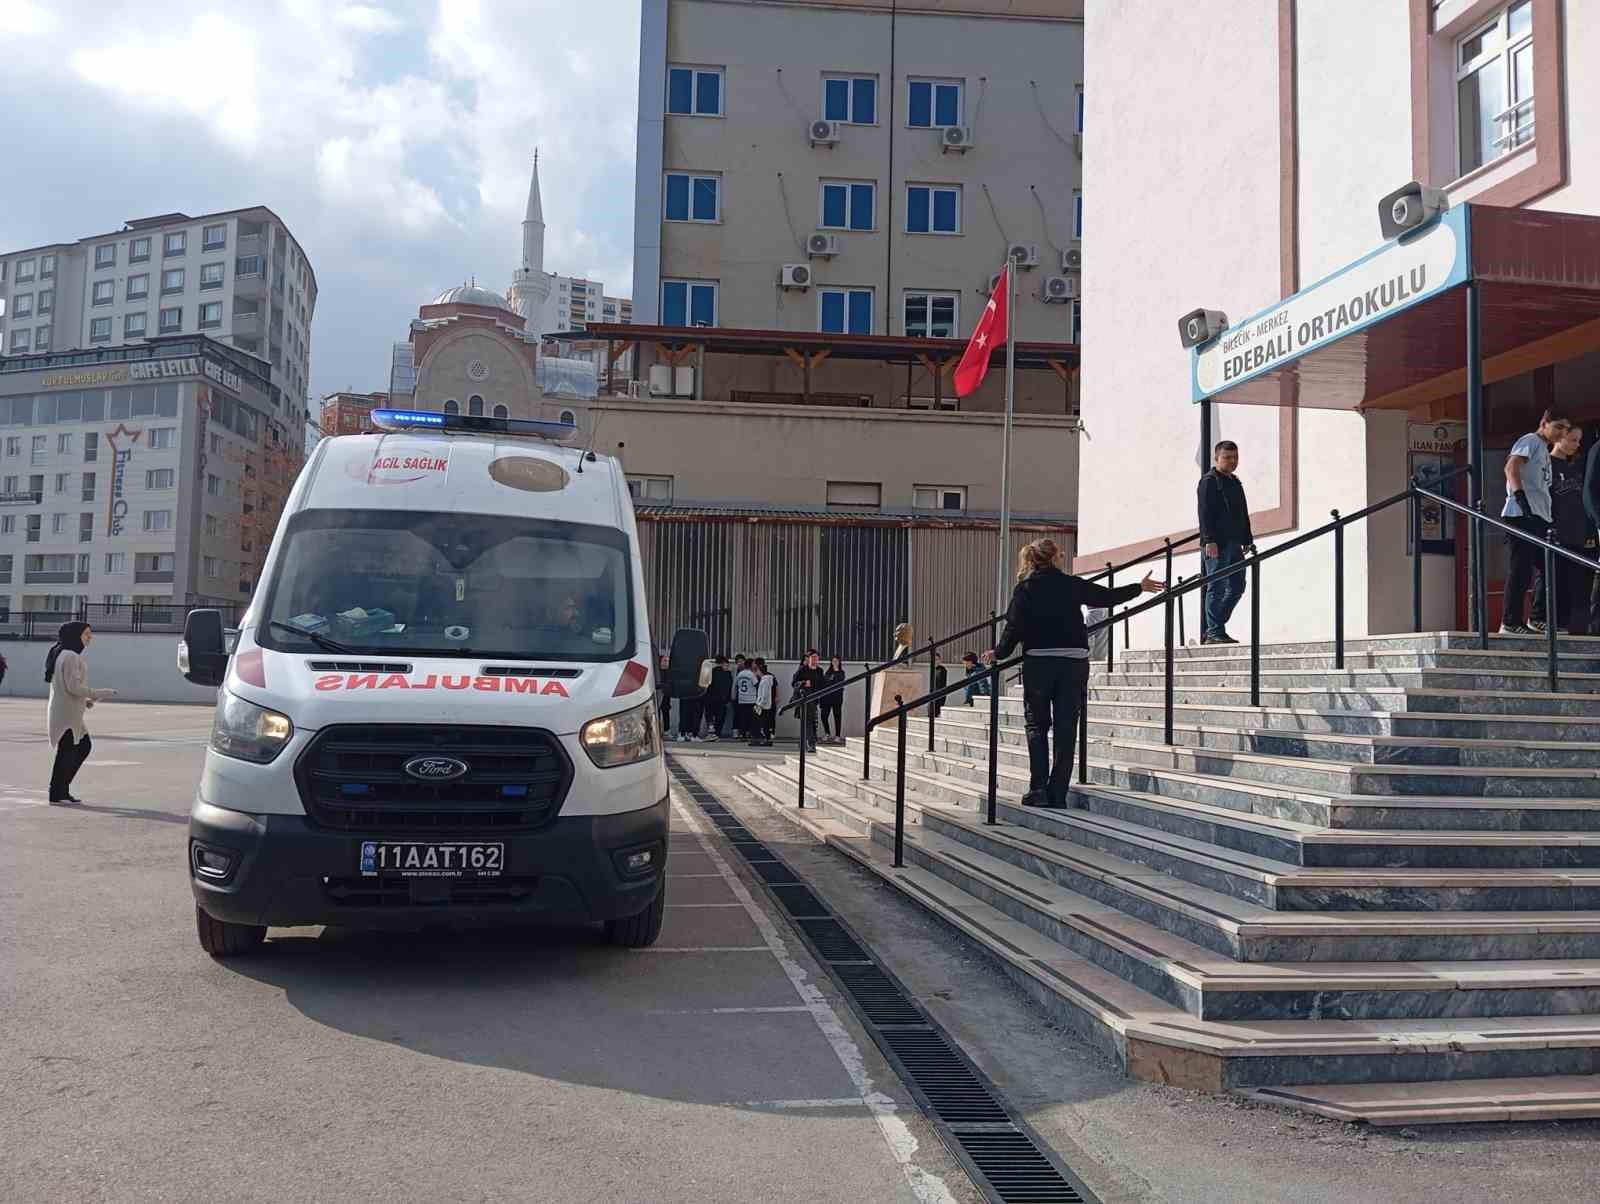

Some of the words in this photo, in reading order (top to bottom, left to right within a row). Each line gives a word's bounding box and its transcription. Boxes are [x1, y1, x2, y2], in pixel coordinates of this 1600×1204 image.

[1223, 325, 1292, 381] EDEBALİ
[1297, 264, 1426, 346] ORTAOKULU
[1256, 310, 1288, 336] MERKEZ
[403, 456, 448, 471] SAĞLIK
[113, 501, 128, 536] Club
[419, 760, 452, 777] Ford
